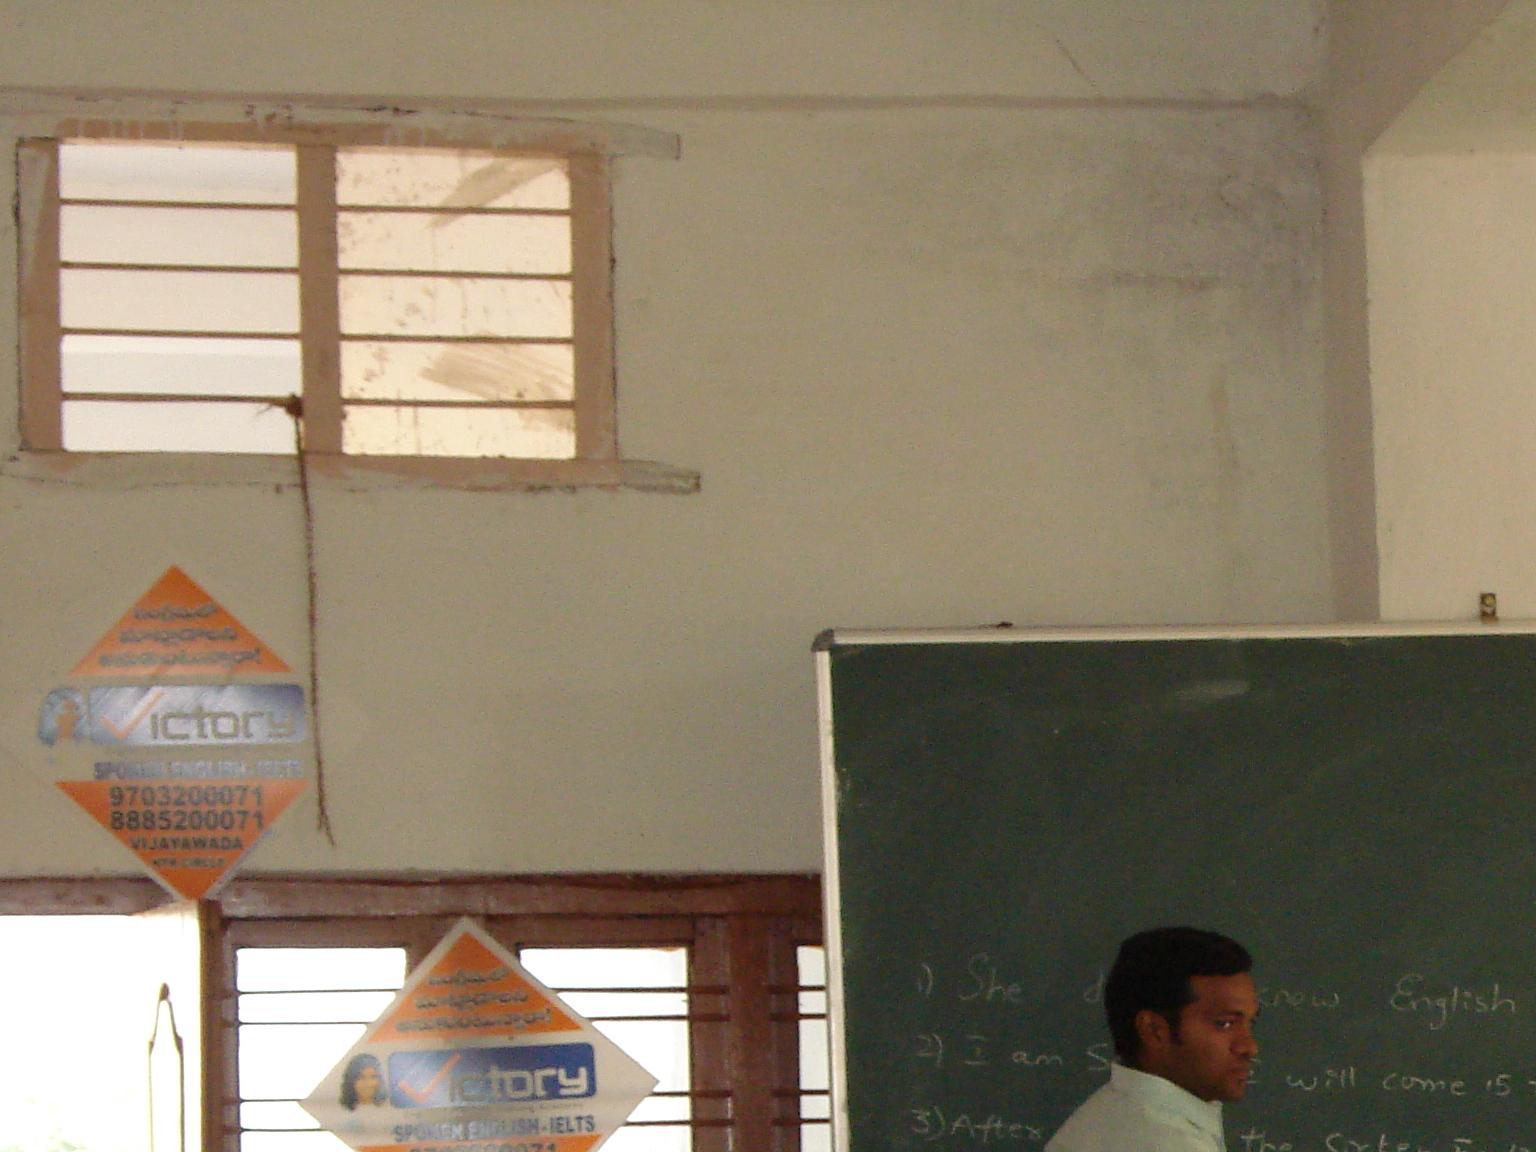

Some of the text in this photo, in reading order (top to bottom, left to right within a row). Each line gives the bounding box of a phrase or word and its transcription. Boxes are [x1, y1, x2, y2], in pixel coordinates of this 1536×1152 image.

[109, 785, 264, 806] 9703200071
[110, 810, 264, 830] 8885200071
[131, 836, 243, 851] VIJAYAWADA
[957, 952, 1021, 1001] She
[1391, 974, 1516, 1030] English
[1012, 1051, 1063, 1065] am
[1286, 1066, 1357, 1091] will
[1382, 1073, 1466, 1097] come
